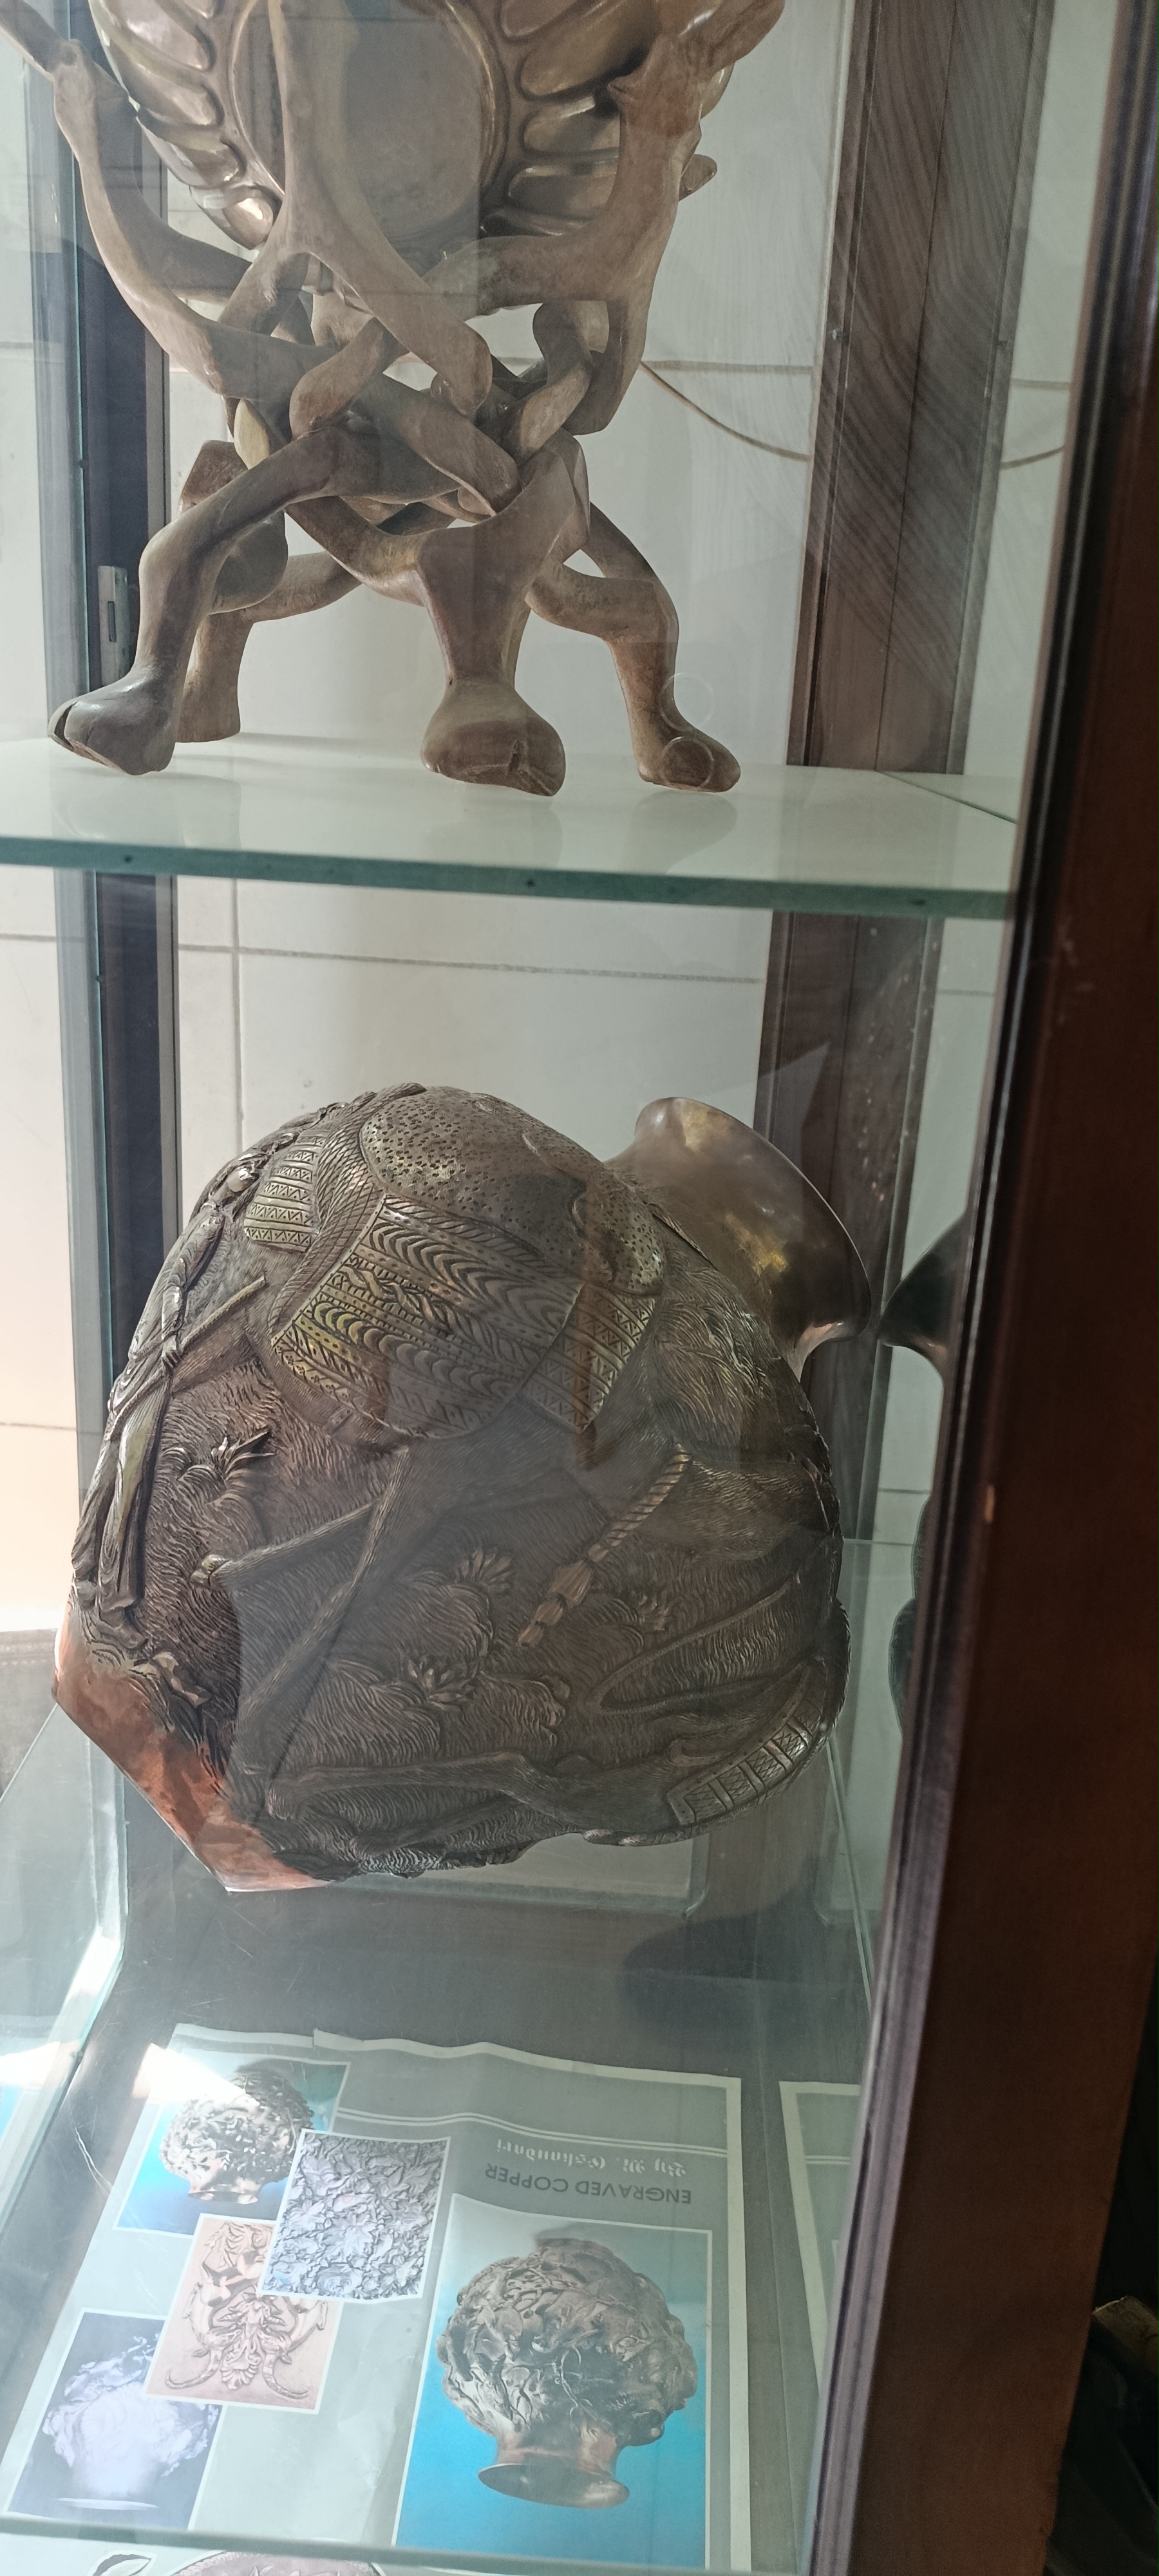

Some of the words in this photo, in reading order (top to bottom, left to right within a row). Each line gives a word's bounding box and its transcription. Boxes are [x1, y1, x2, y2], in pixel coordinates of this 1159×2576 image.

[497, 2139, 606, 2169] Eskandari
[485, 2163, 569, 2192] COPPER
[654, 2158, 686, 2177] By
[575, 2181, 692, 2204] ENGRAVED
